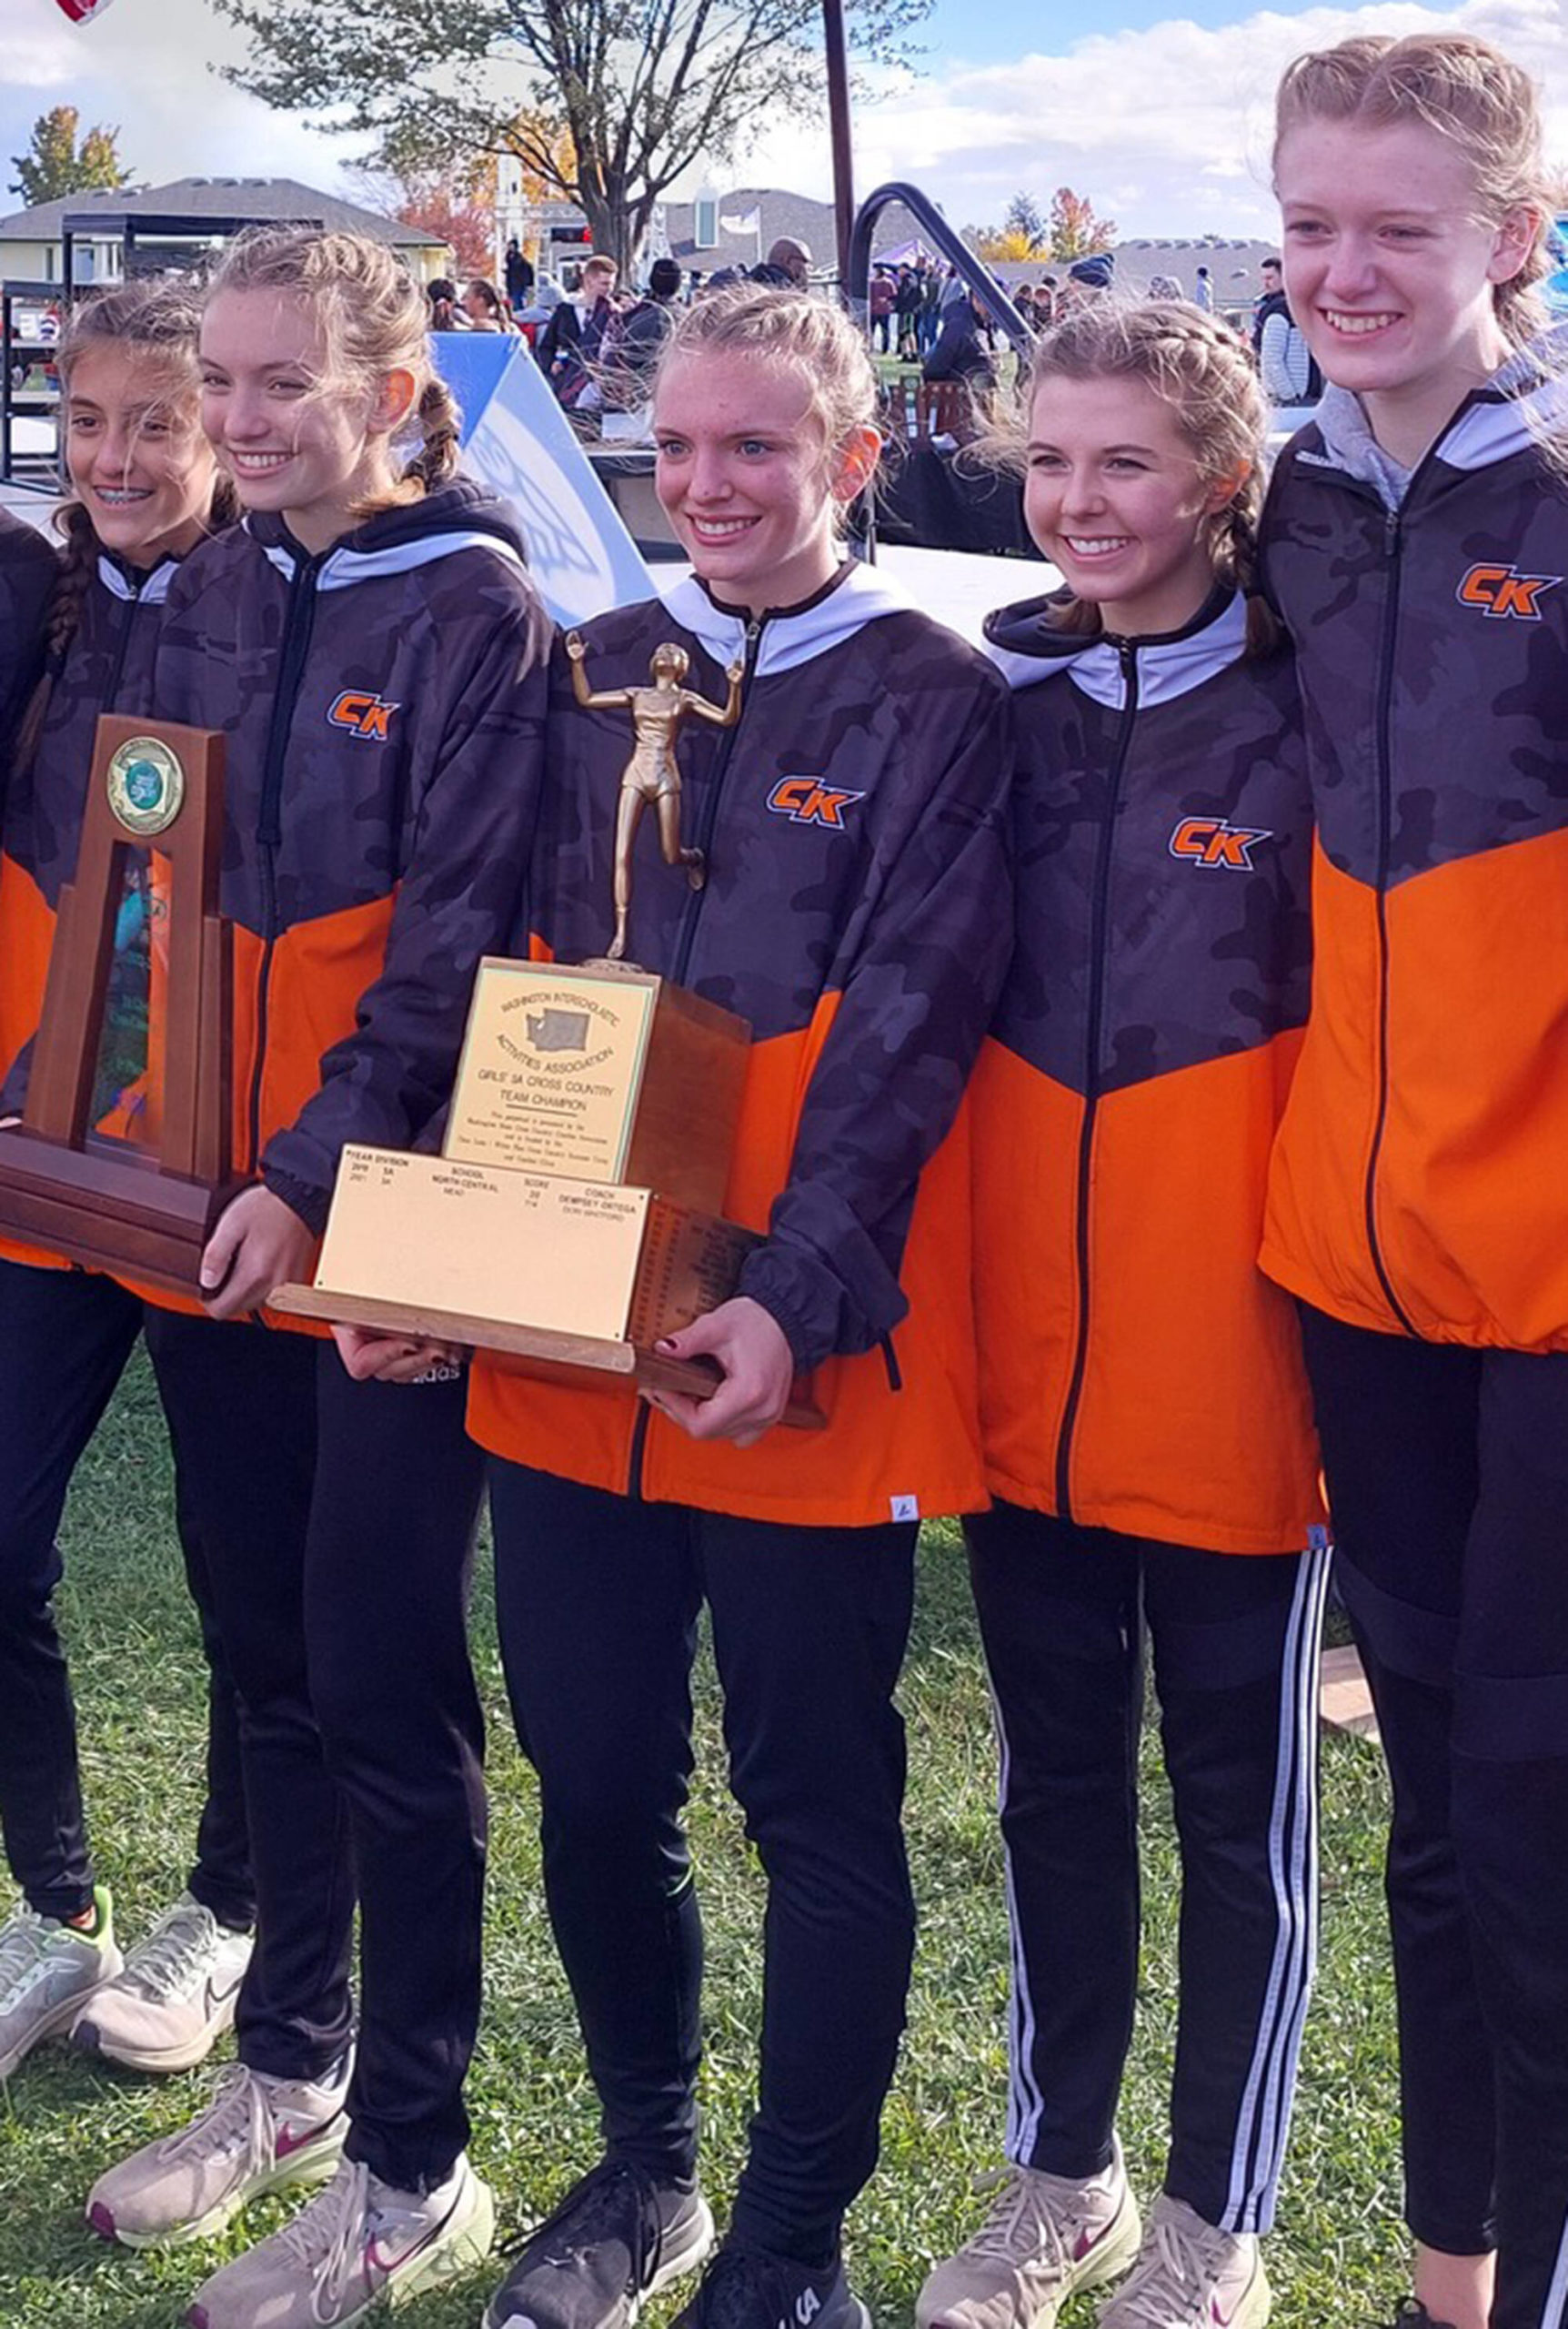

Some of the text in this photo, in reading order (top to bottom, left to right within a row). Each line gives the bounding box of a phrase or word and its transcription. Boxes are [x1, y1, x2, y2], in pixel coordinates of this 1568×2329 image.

[1457, 564, 1562, 619] CK
[329, 691, 399, 740] CK
[768, 777, 862, 827] CK
[1171, 818, 1270, 869] CK
[501, 993, 551, 1013] WASHINGTON
[497, 1034, 614, 1074] ACTIVITIES ASSOCIATION
[500, 1089, 587, 1112] TEAM CHAMPION
[526, 1075, 562, 1091] CROSS
[564, 1081, 614, 1097] COUNTRY
[351, 1152, 373, 1161] YEAR
[374, 1154, 409, 1167] DIVISION
[452, 1167, 484, 1180] SCHOOL
[584, 1187, 615, 1200] COACH
[432, 1175, 460, 1186] NORTH
